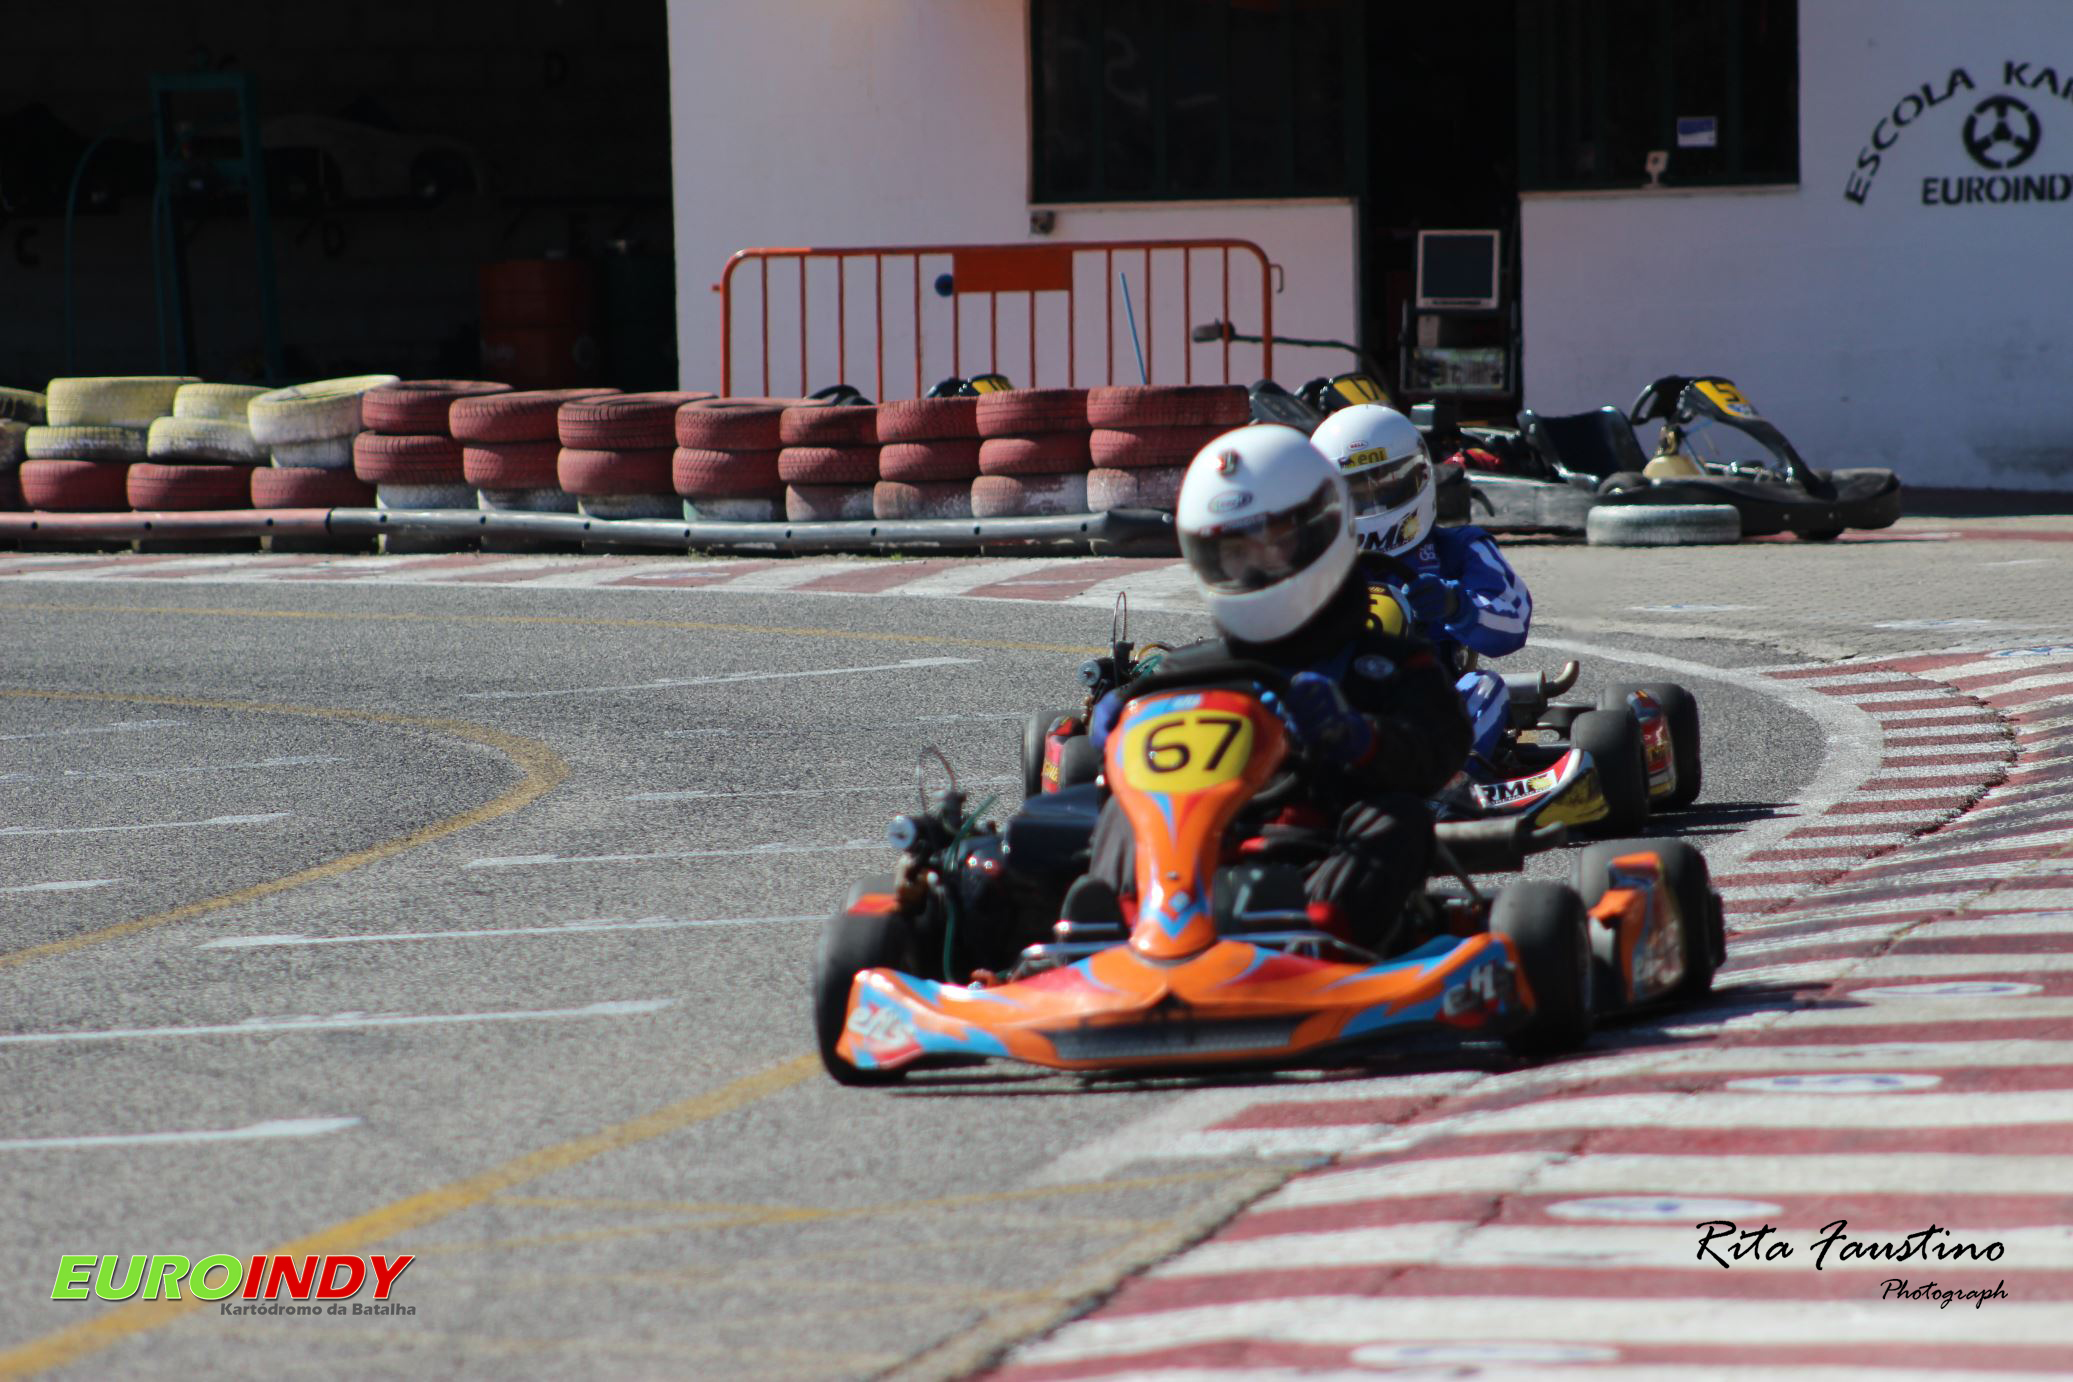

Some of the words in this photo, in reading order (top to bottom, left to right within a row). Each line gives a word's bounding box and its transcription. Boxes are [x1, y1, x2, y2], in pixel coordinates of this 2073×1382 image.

[1844, 66, 1976, 206] ESCOLA
[1921, 174, 2073, 206] EUROIND
[1358, 450, 1386, 465] eni
[1144, 719, 1243, 774] 67
